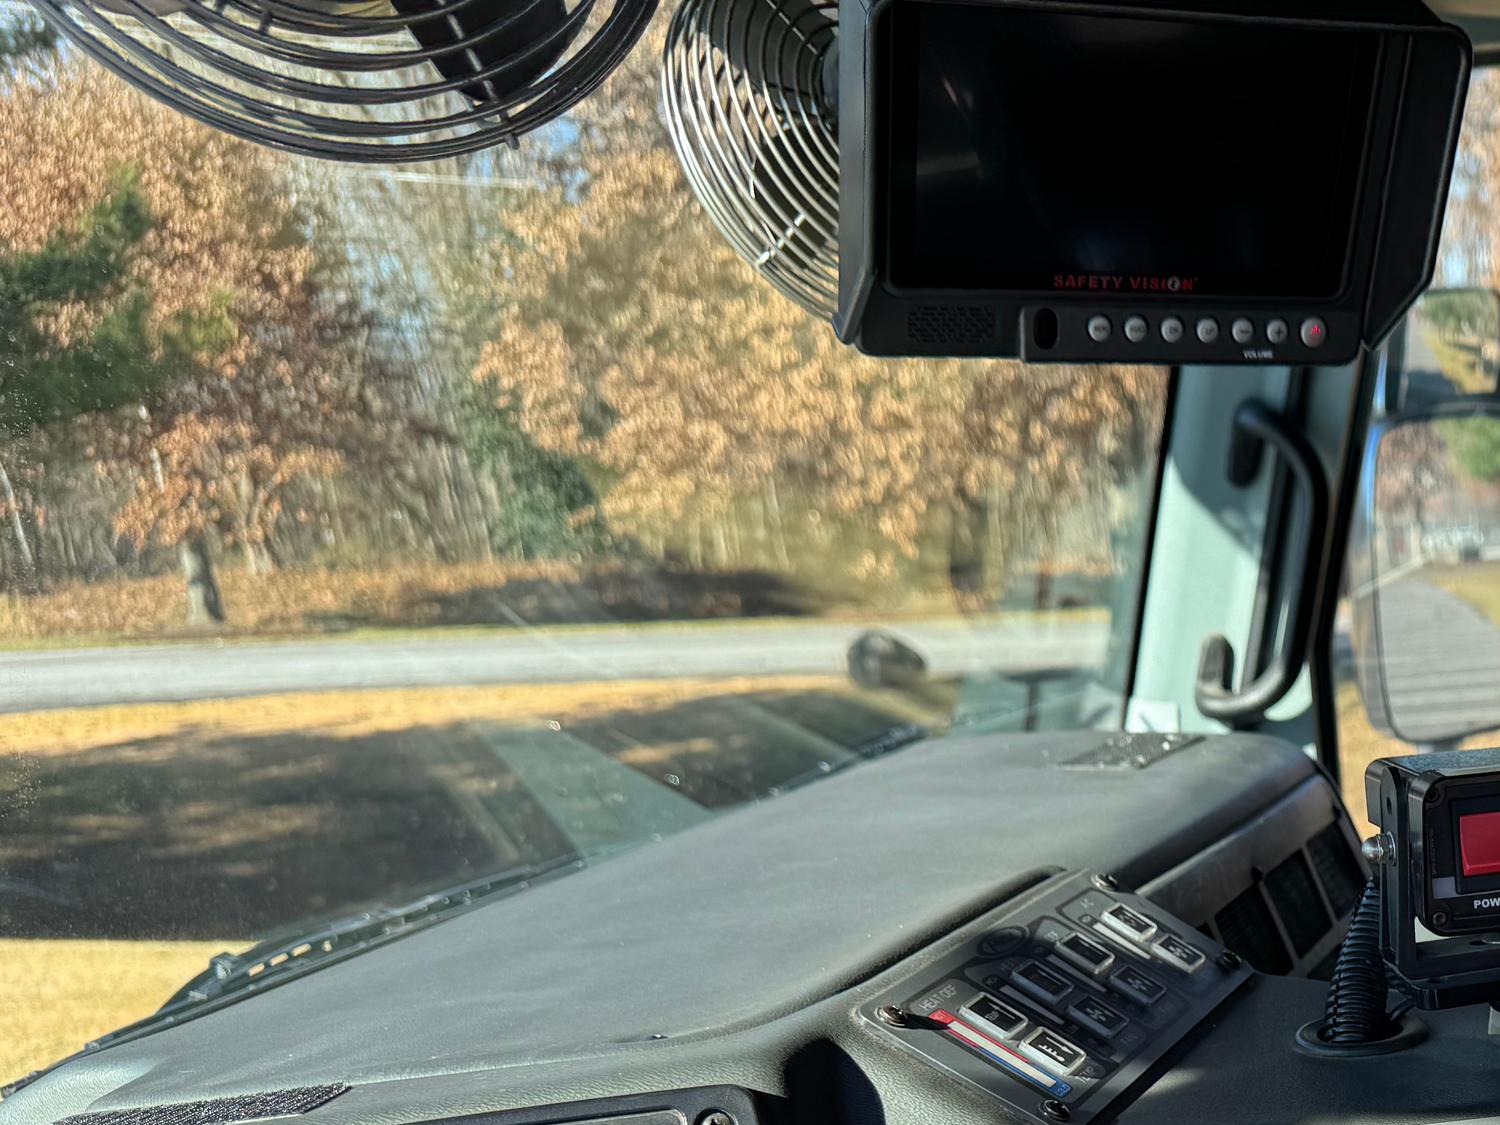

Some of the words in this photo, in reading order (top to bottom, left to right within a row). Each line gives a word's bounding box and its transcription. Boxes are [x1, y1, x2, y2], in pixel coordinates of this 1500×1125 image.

[1054, 275, 1123, 289] SAFETY
[1130, 276, 1193, 290] VISION
[1243, 350, 1273, 359] VOLUME
